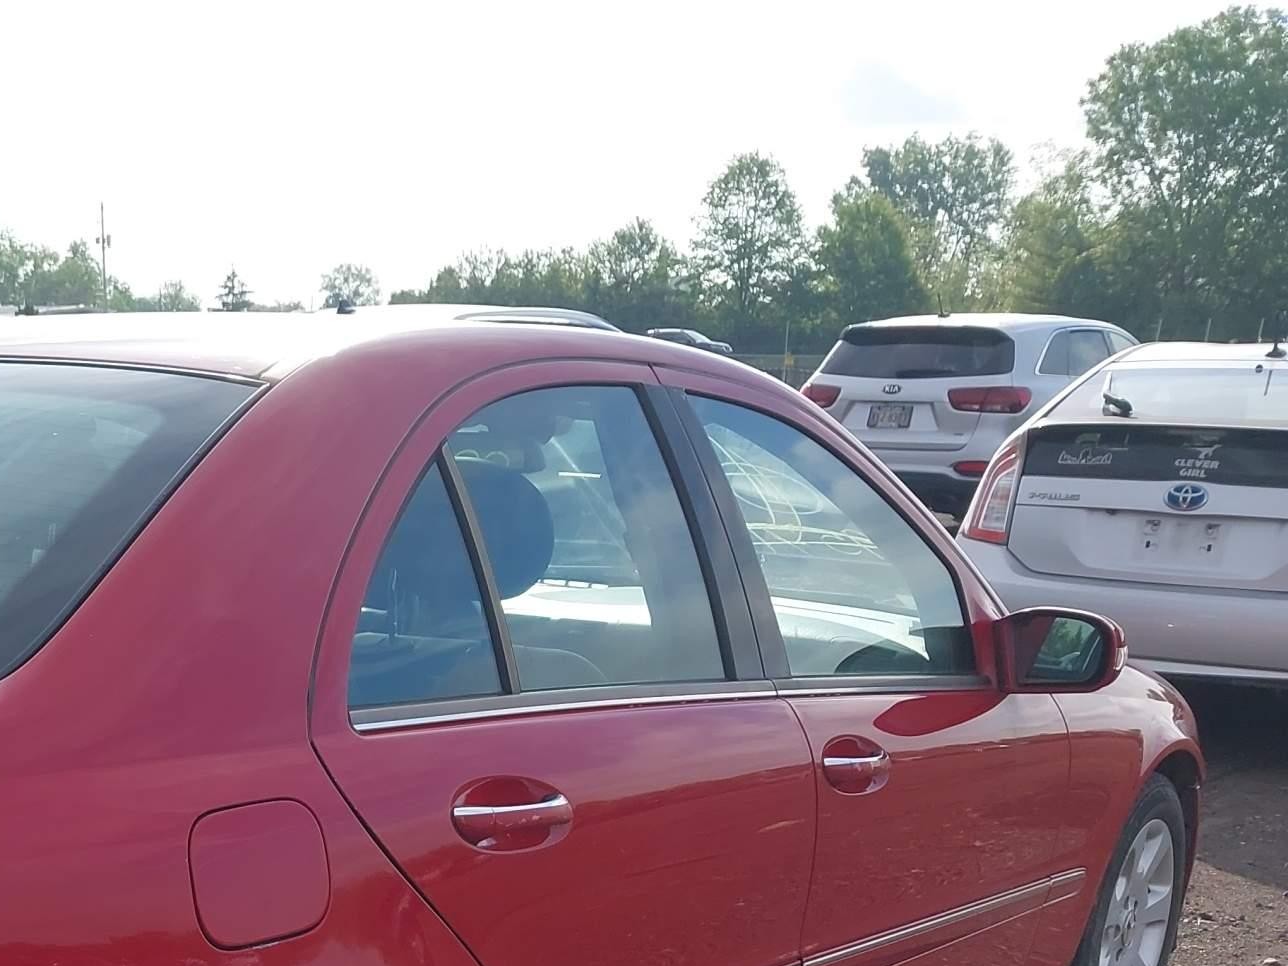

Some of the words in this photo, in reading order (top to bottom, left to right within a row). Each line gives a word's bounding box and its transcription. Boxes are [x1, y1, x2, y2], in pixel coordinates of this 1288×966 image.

[883, 384, 900, 393] KIA
[1174, 458, 1220, 469] CLEVER
[1179, 468, 1208, 478] GIRL
